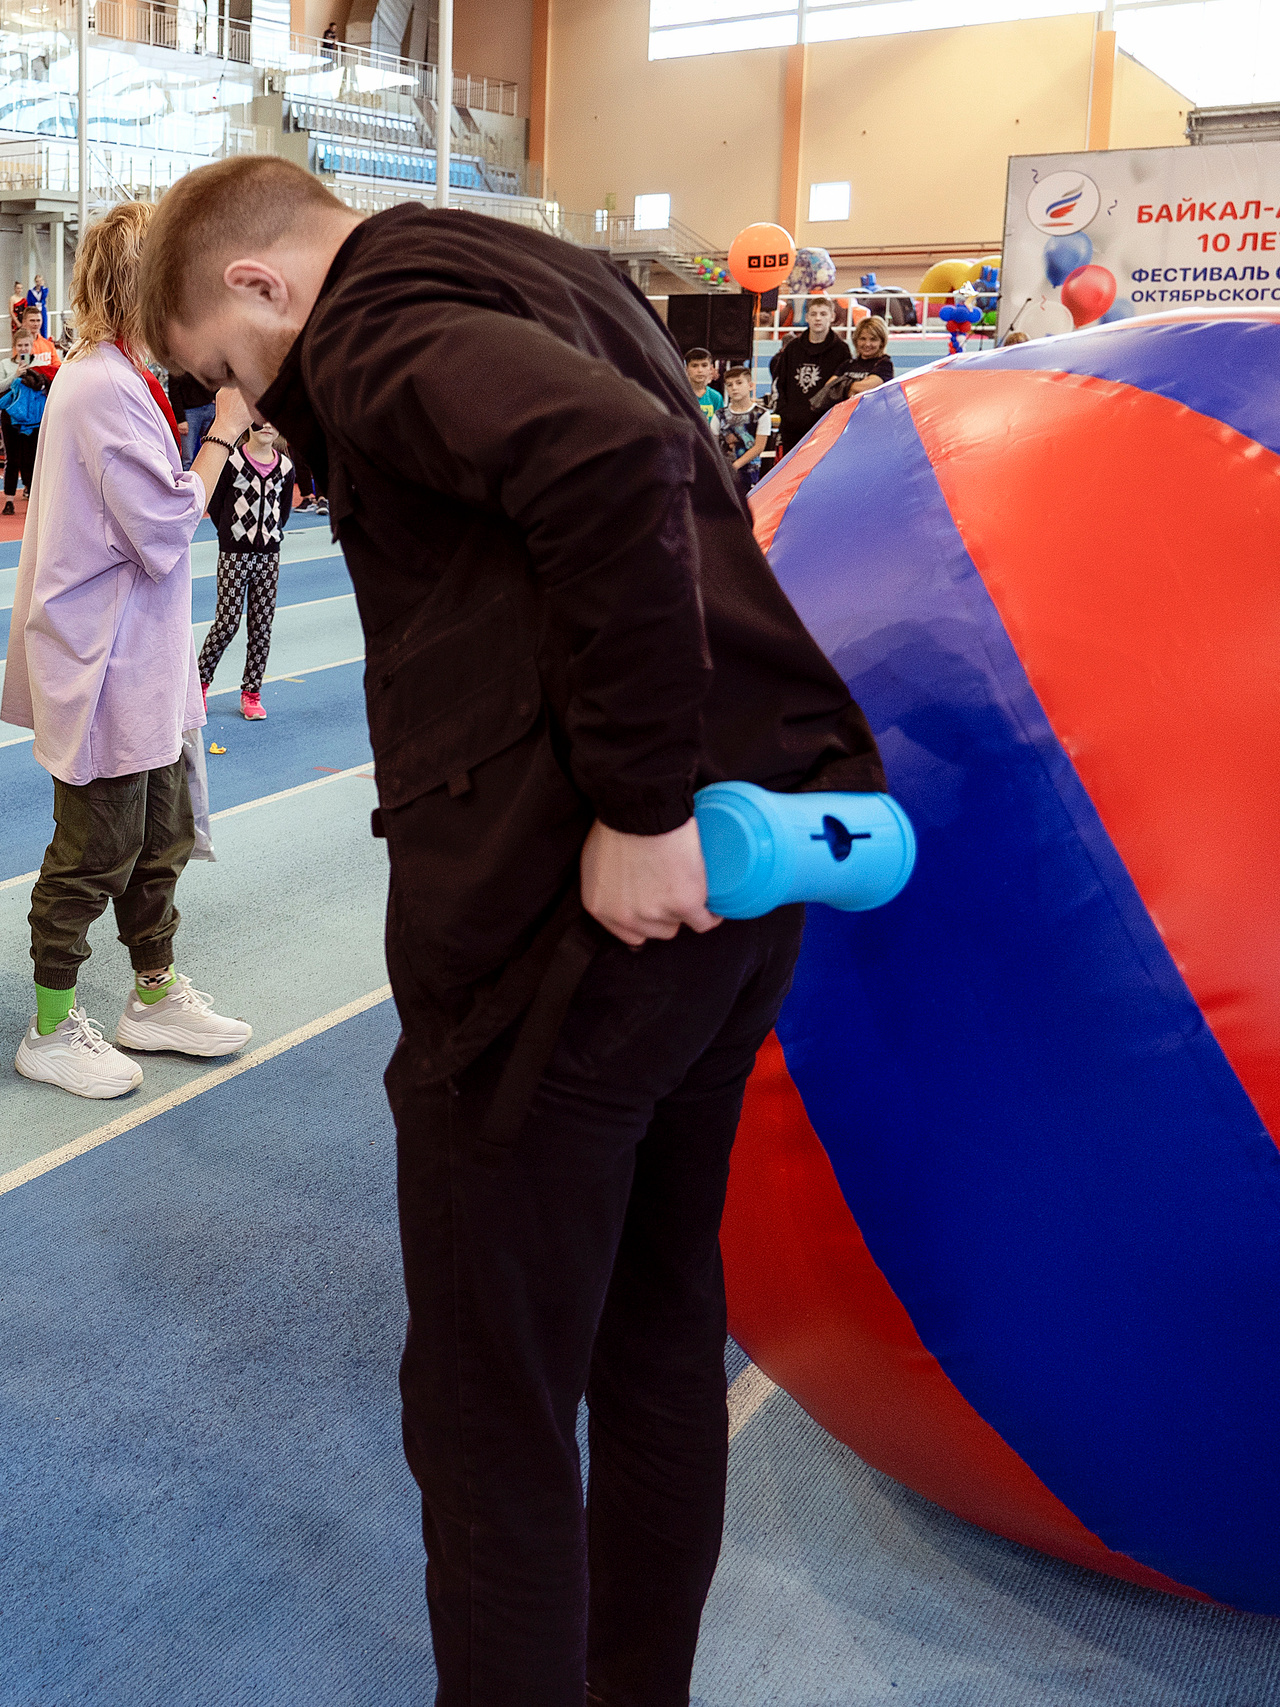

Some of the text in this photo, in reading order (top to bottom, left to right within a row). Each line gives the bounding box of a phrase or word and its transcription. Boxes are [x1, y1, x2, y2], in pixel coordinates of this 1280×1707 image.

[1137, 197, 1280, 223] БАЙКАЛ-
[1197, 231, 1280, 252] 10 ЛЕ
[1131, 266, 1270, 283] ФЕСТИВАЛЬ
